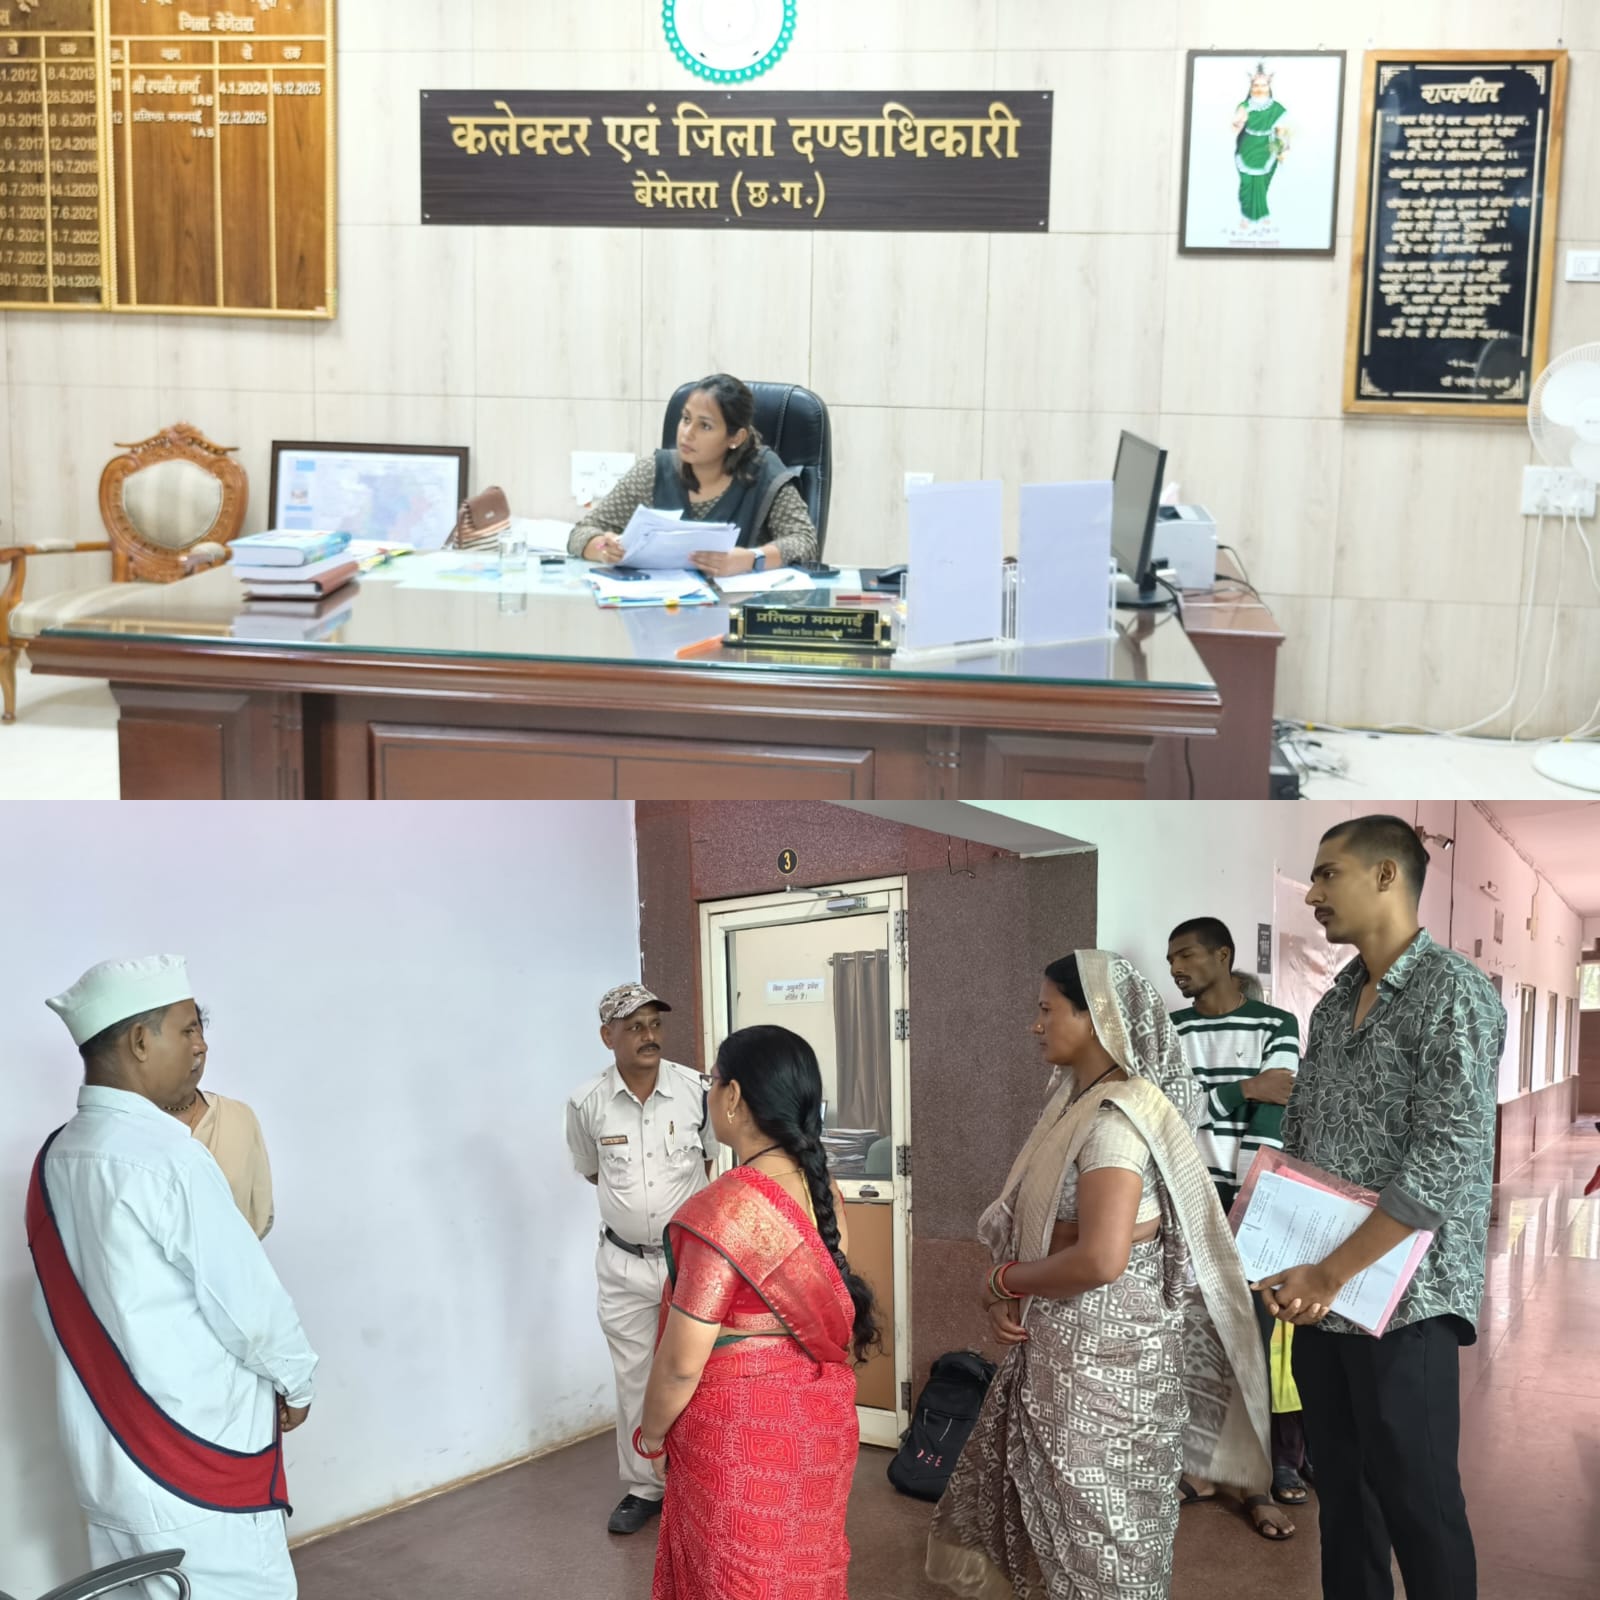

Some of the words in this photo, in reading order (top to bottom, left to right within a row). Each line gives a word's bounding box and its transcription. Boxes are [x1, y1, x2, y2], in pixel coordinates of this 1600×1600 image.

[192, 94, 213, 107] IAS
[1420, 76, 1505, 104] राजगीत
[192, 127, 214, 138] IAS
[447, 100, 592, 157] कलेक्टर
[602, 102, 662, 163] एवं
[672, 101, 777, 157] जिला
[787, 101, 1021, 164] दण्डाधिकारी
[632, 170, 720, 209] बेमेतरा
[783, 852, 791, 870] 3
